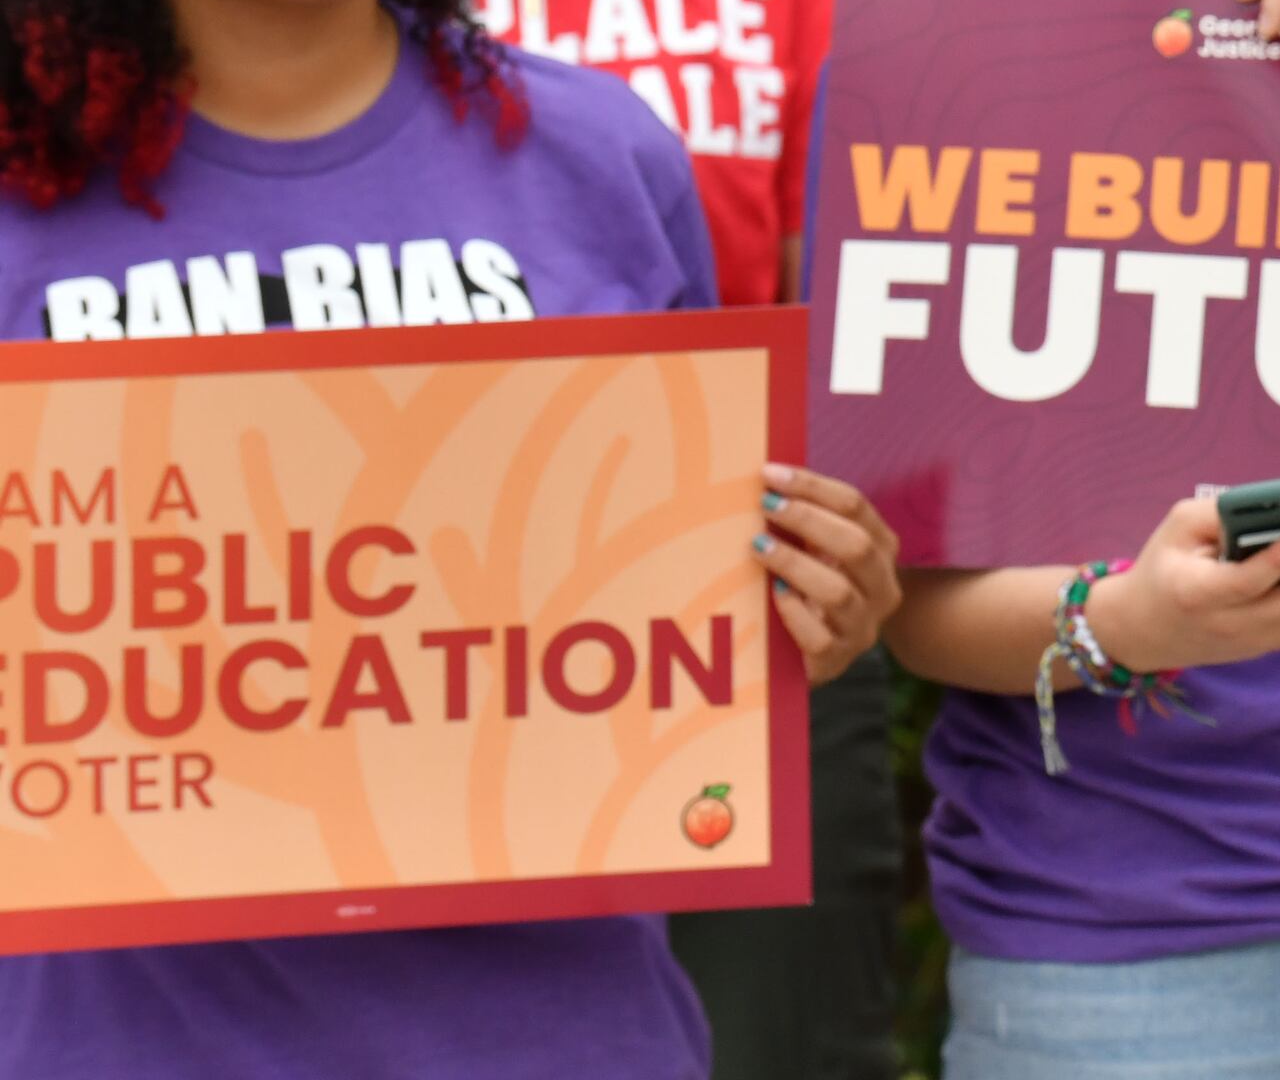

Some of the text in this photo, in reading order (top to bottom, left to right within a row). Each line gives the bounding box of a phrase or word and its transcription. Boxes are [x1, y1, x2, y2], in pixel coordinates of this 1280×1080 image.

[849, 143, 1042, 237] WE
[281, 238, 535, 332] BIAS
[147, 463, 200, 523] A
[0, 615, 735, 747] DUCATION
[0, 752, 216, 819] OTER
